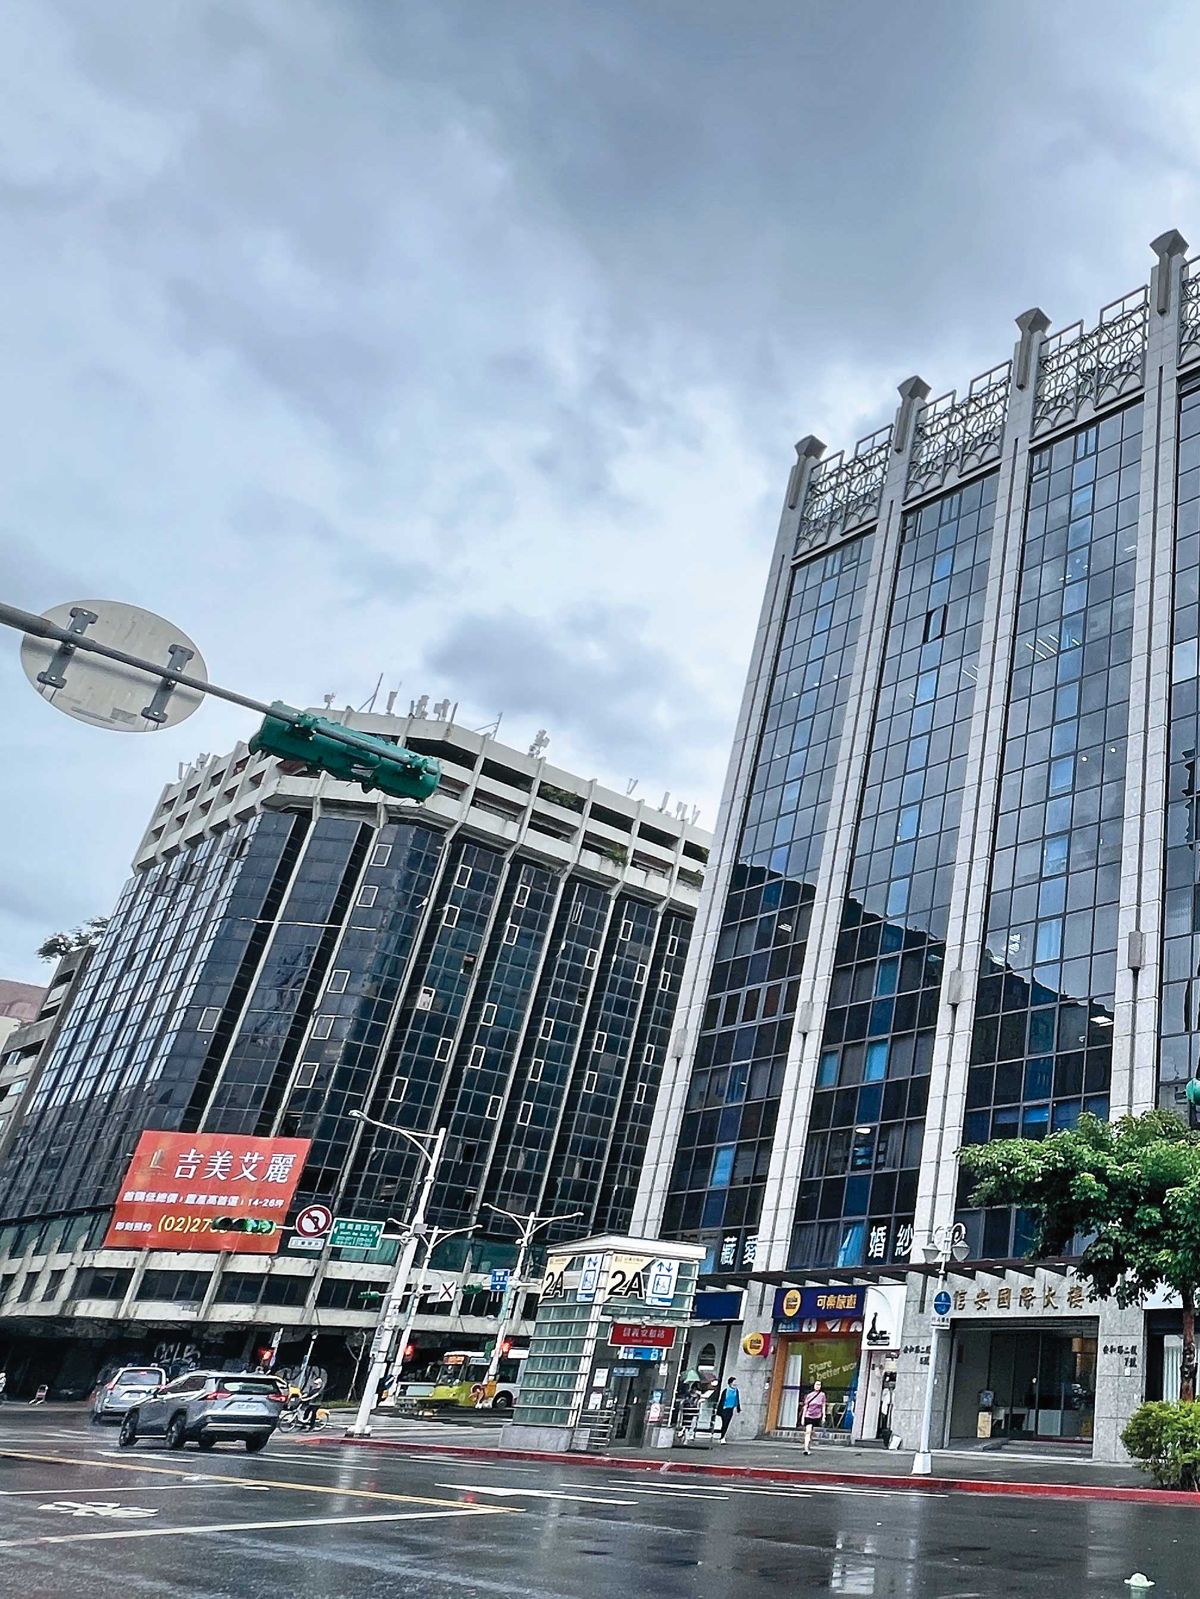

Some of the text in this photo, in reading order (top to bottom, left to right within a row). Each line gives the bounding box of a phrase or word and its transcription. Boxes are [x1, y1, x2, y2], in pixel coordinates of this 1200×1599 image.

[174, 1148, 297, 1184] 吉美艾麗
[868, 1223, 915, 1259] 婚紗
[542, 1271, 564, 1297] 2A
[607, 1269, 644, 1298] 2A
[953, 1285, 1085, 1311] 信安國際大樓
[808, 1360, 832, 1374] Share
[816, 1366, 841, 1380] better
